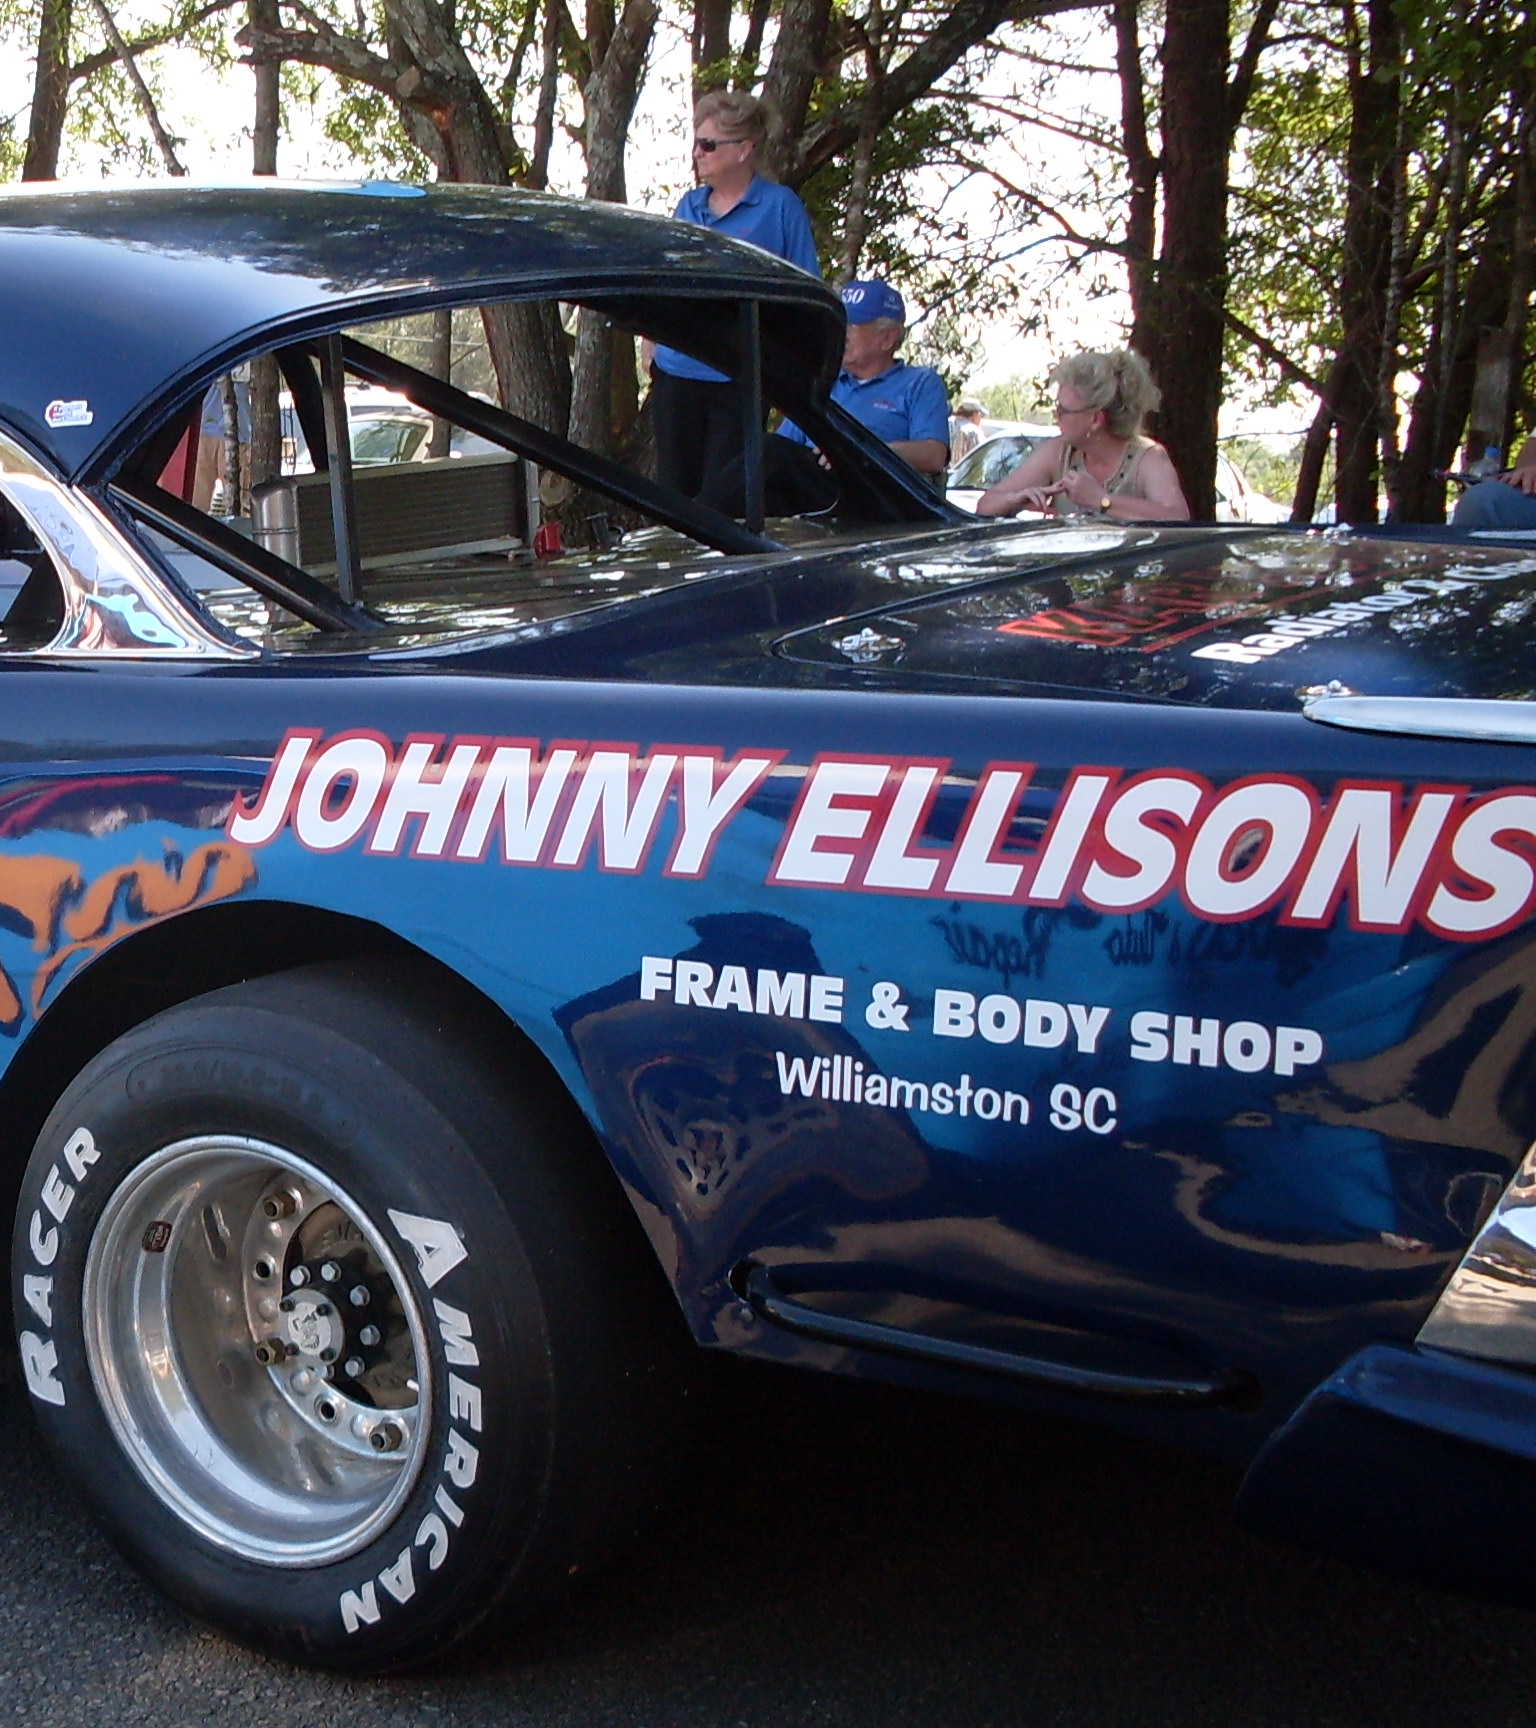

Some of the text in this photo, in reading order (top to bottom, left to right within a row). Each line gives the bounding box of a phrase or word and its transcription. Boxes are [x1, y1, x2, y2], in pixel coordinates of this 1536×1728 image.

[1189, 589, 1431, 665] Radiator
[225, 726, 1536, 941] JOHNNY ELLISONS
[640, 955, 1324, 1076] FRAME & BODY SHOP
[774, 1049, 1119, 1136] Williamston SC
[19, 1125, 102, 1407] RACER
[339, 1206, 484, 1634] AMERICAN
